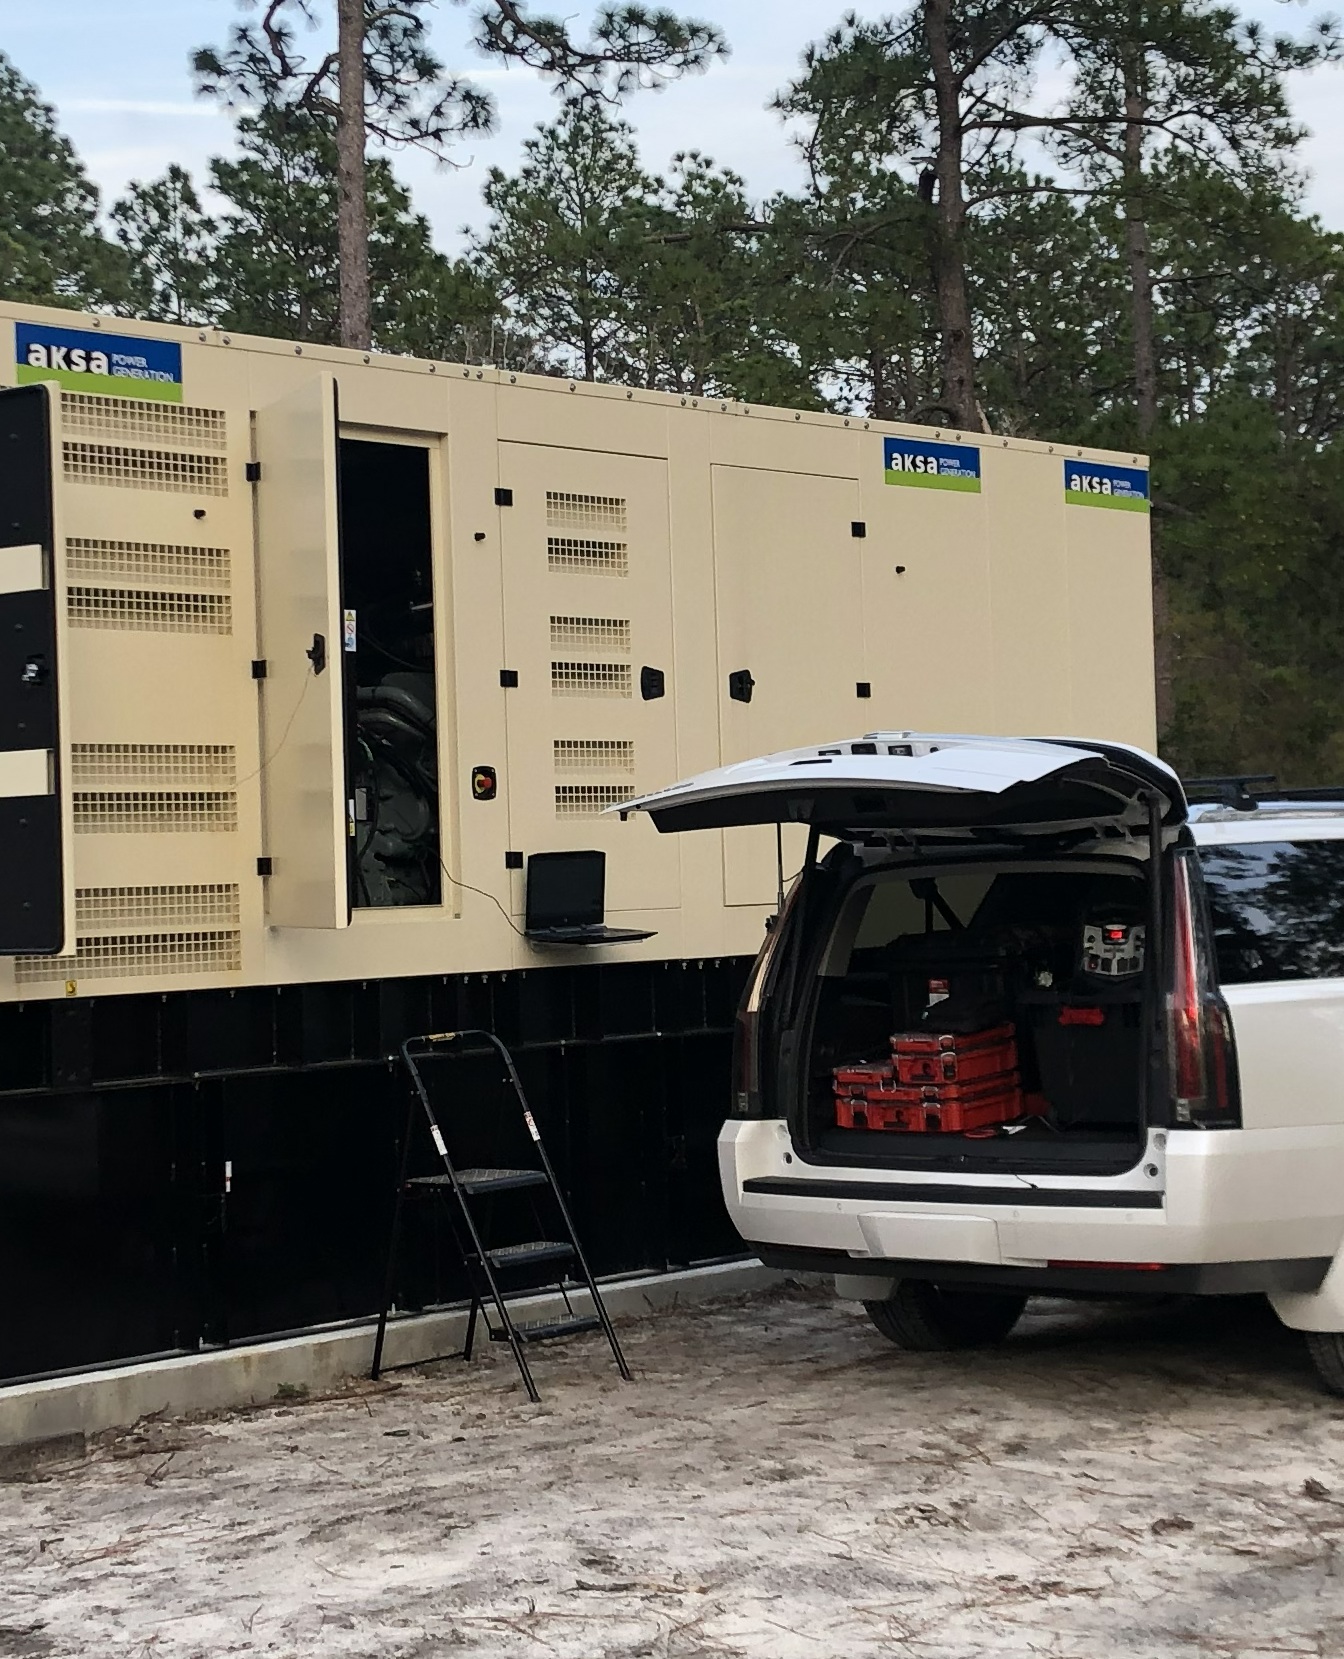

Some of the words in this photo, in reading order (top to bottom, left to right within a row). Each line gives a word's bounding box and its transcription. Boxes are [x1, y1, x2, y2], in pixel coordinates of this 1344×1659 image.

[27, 342, 110, 376] aksa
[112, 353, 149, 369] POWER
[113, 366, 175, 384] GENERATION
[891, 452, 938, 475] aksa
[1070, 473, 1112, 496] aksa
